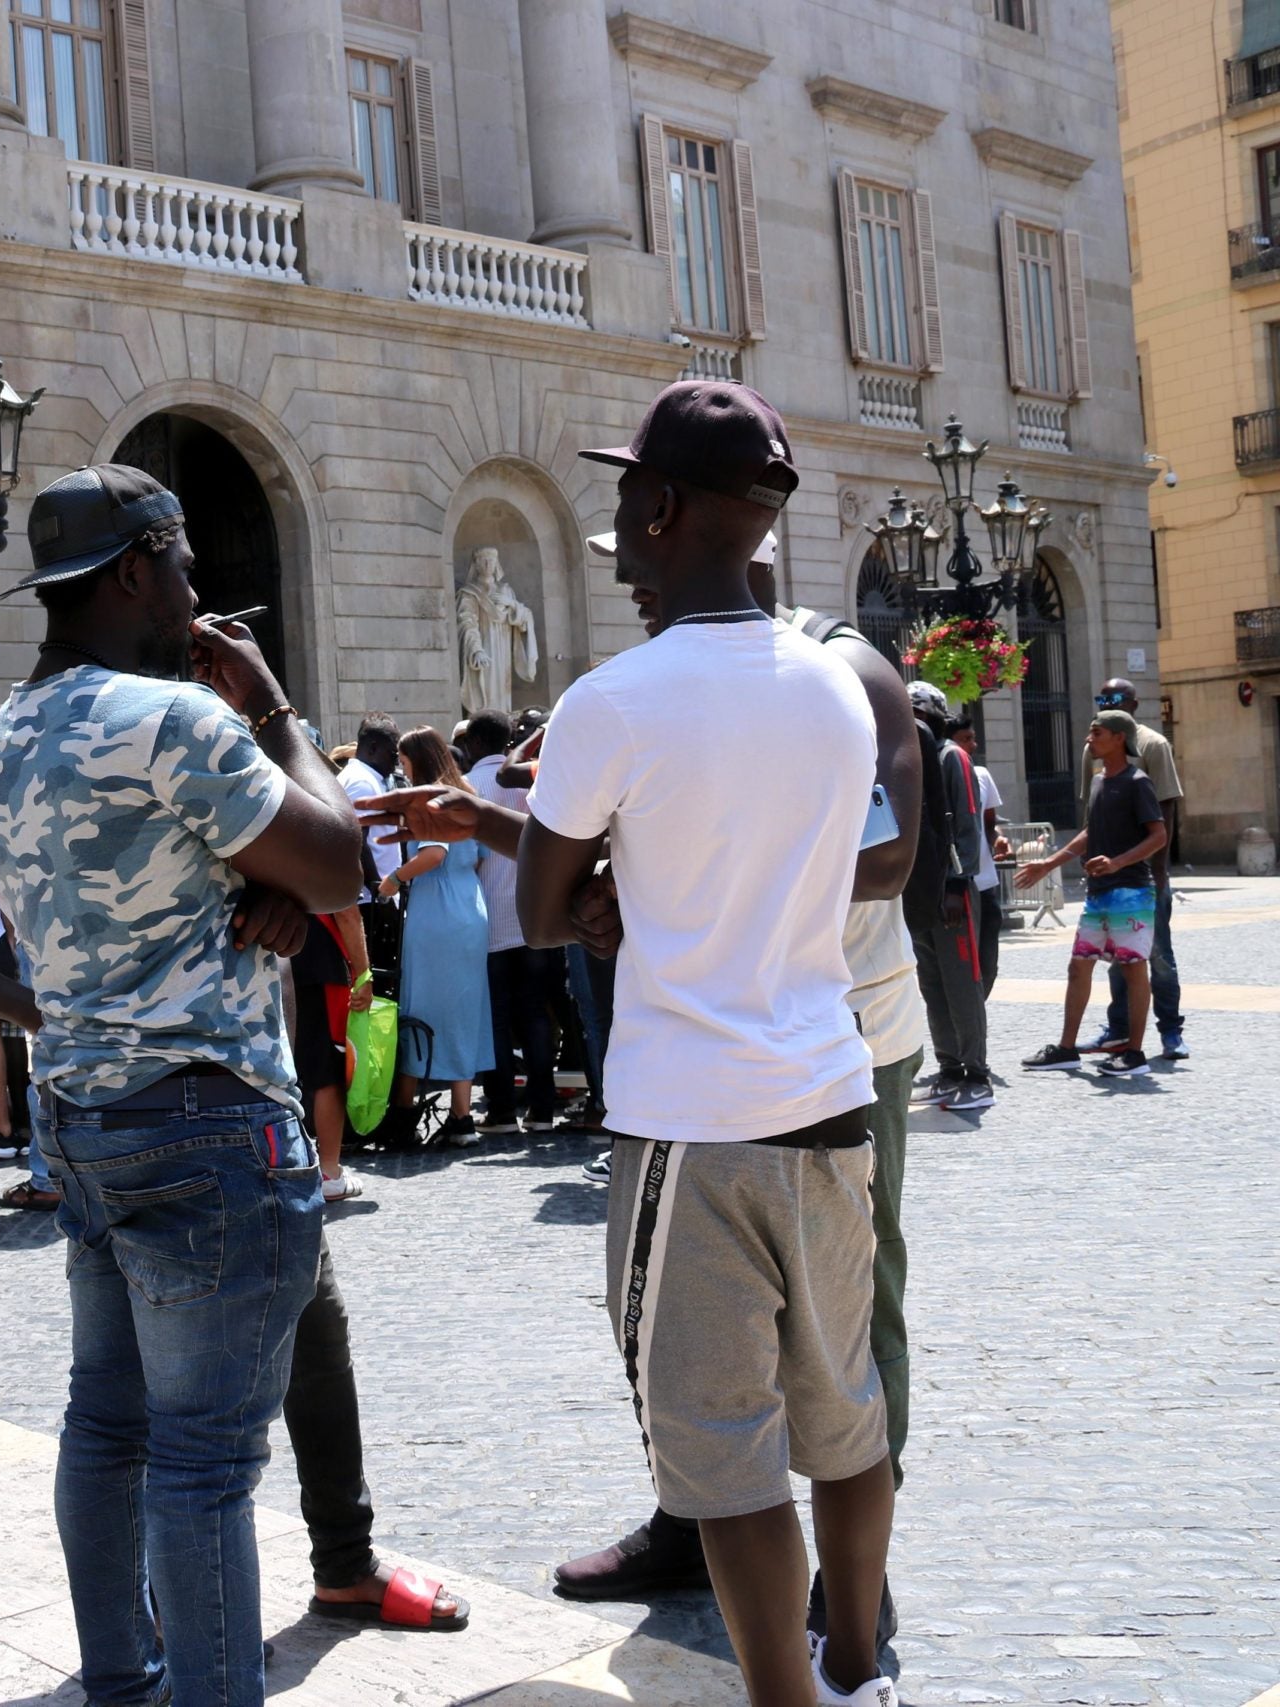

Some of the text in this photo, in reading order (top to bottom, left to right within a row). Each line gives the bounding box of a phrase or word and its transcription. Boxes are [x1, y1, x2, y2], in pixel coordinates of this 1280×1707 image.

[646, 1151, 666, 1203] DESIGN
[626, 1264, 645, 1340] NEW DESIGN
[876, 1686, 891, 1697] JUST
[880, 1695, 890, 1703] DO
